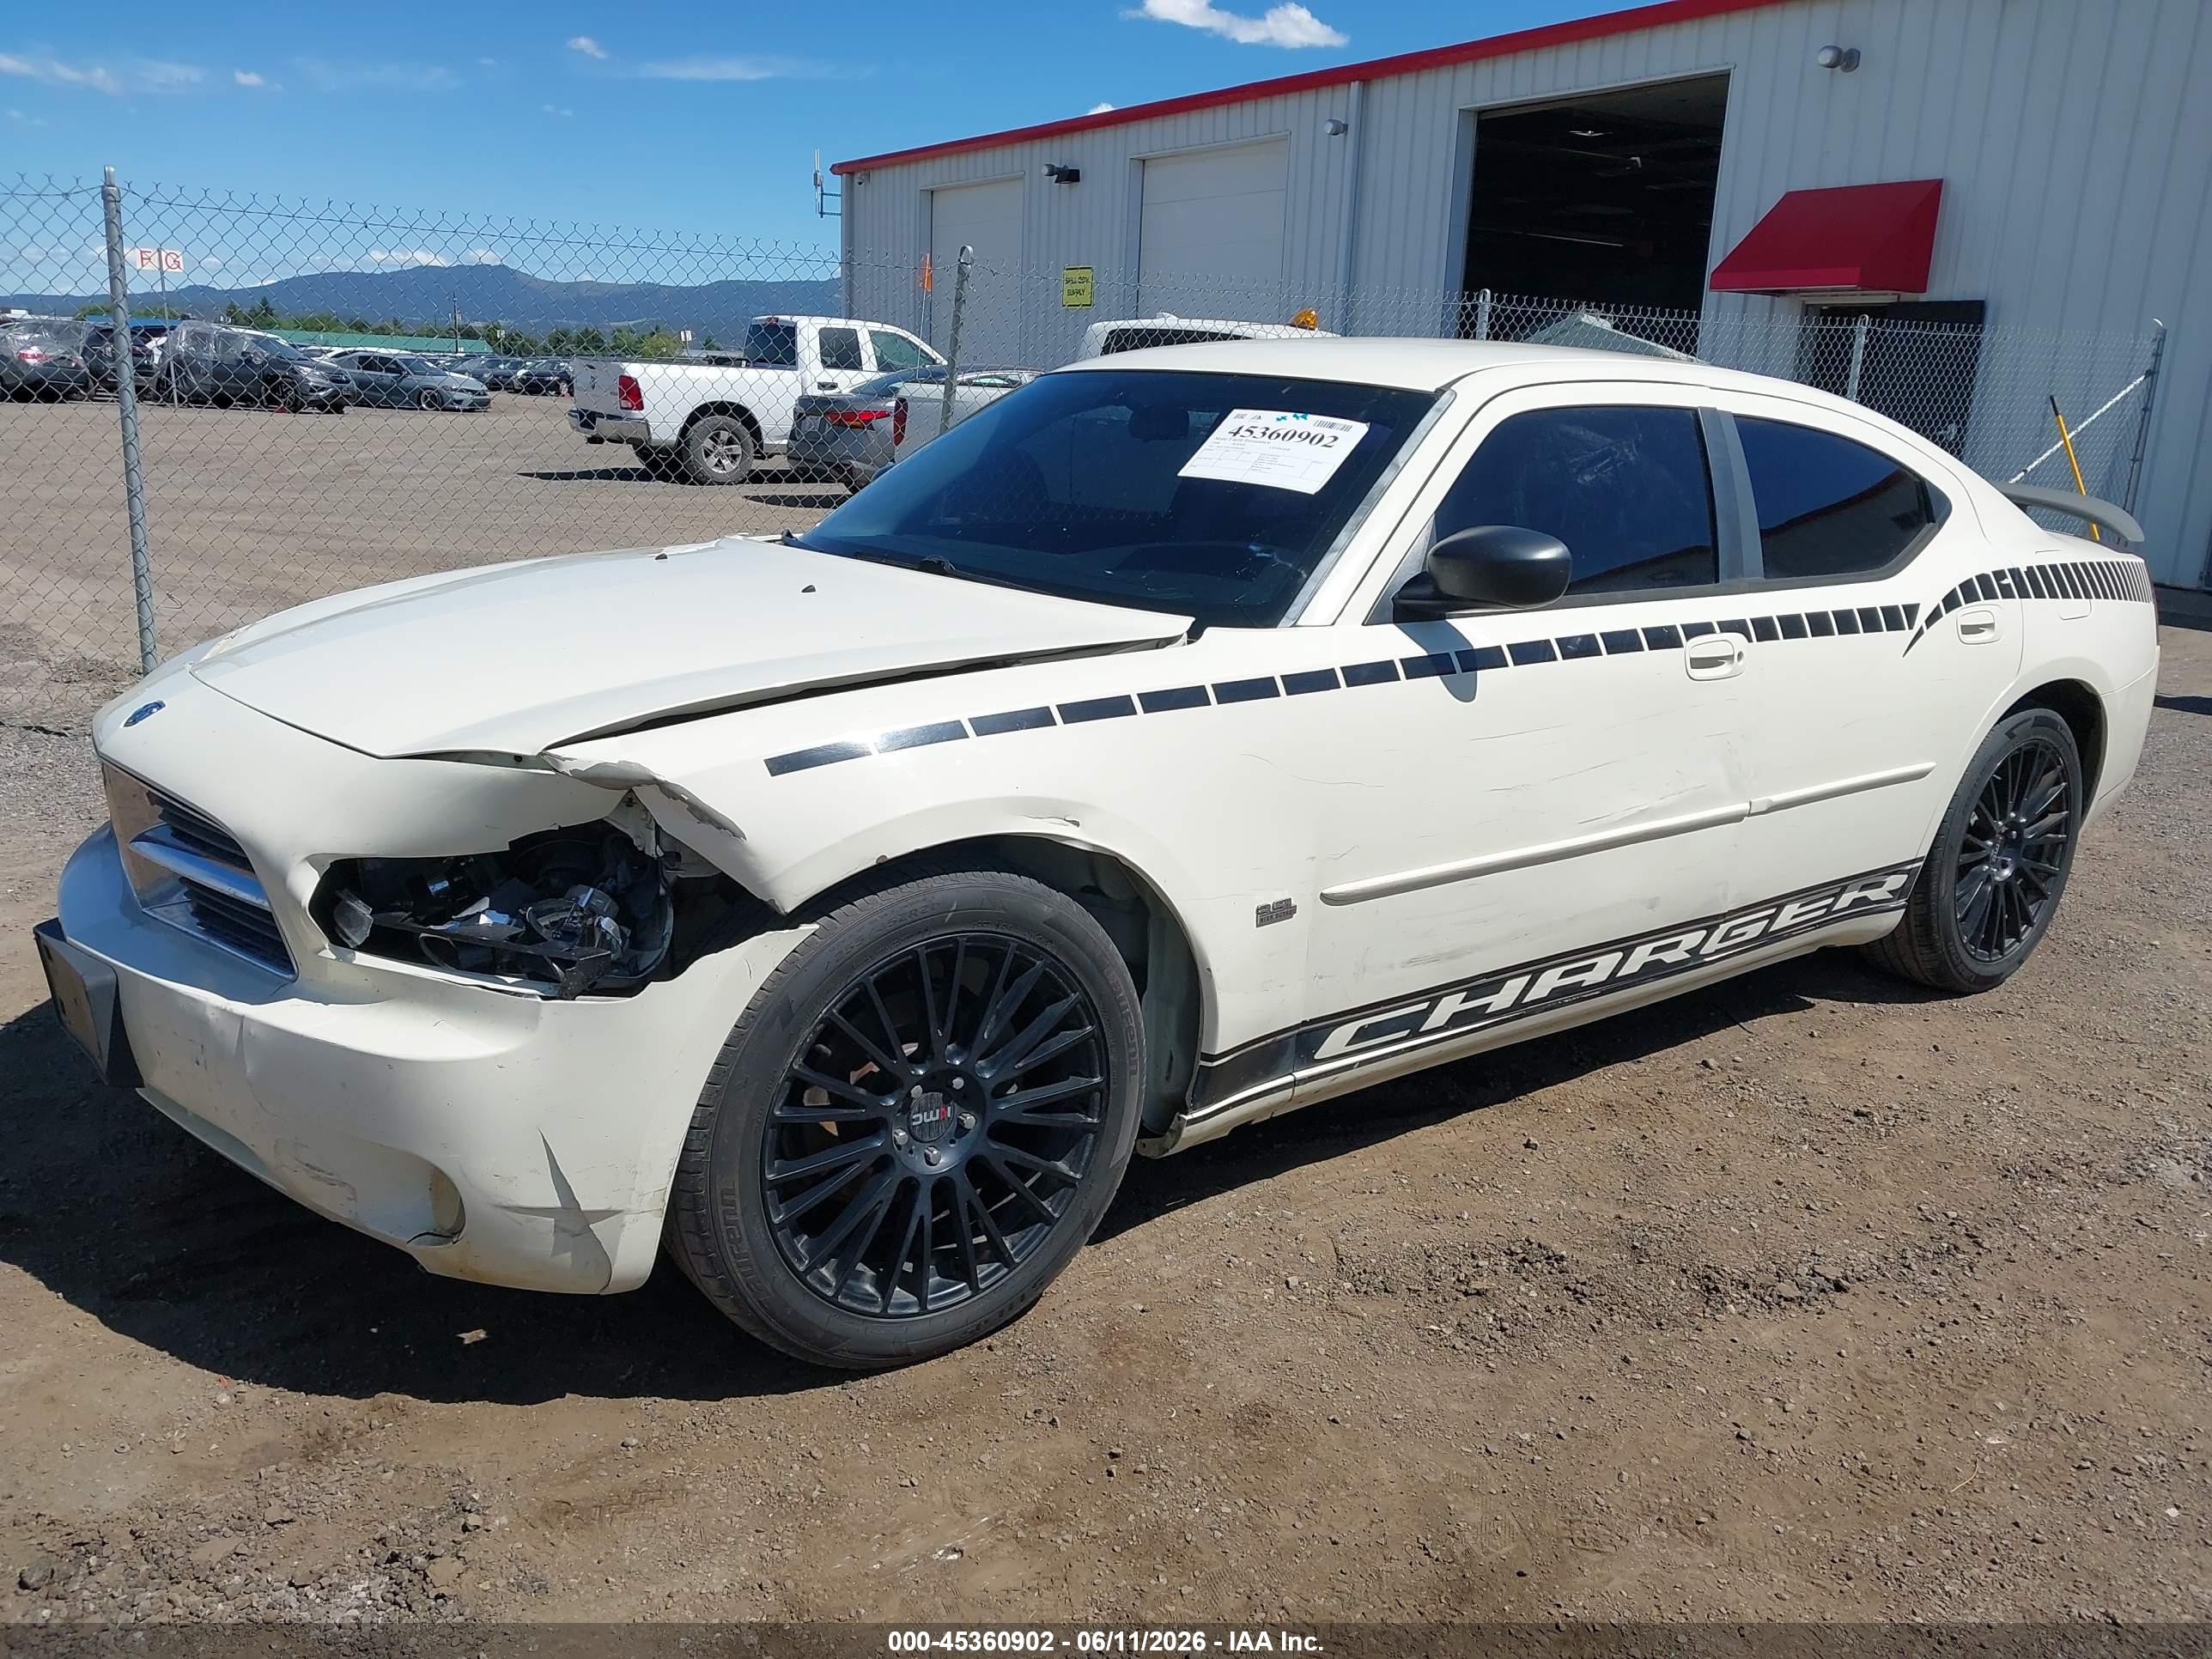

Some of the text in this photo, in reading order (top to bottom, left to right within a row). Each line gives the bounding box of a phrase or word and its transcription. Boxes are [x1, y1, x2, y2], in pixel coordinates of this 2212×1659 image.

[140, 250, 181, 270] F G
[1228, 424, 1340, 449] 45360902
[1313, 873, 1909, 1060] CHARGER
